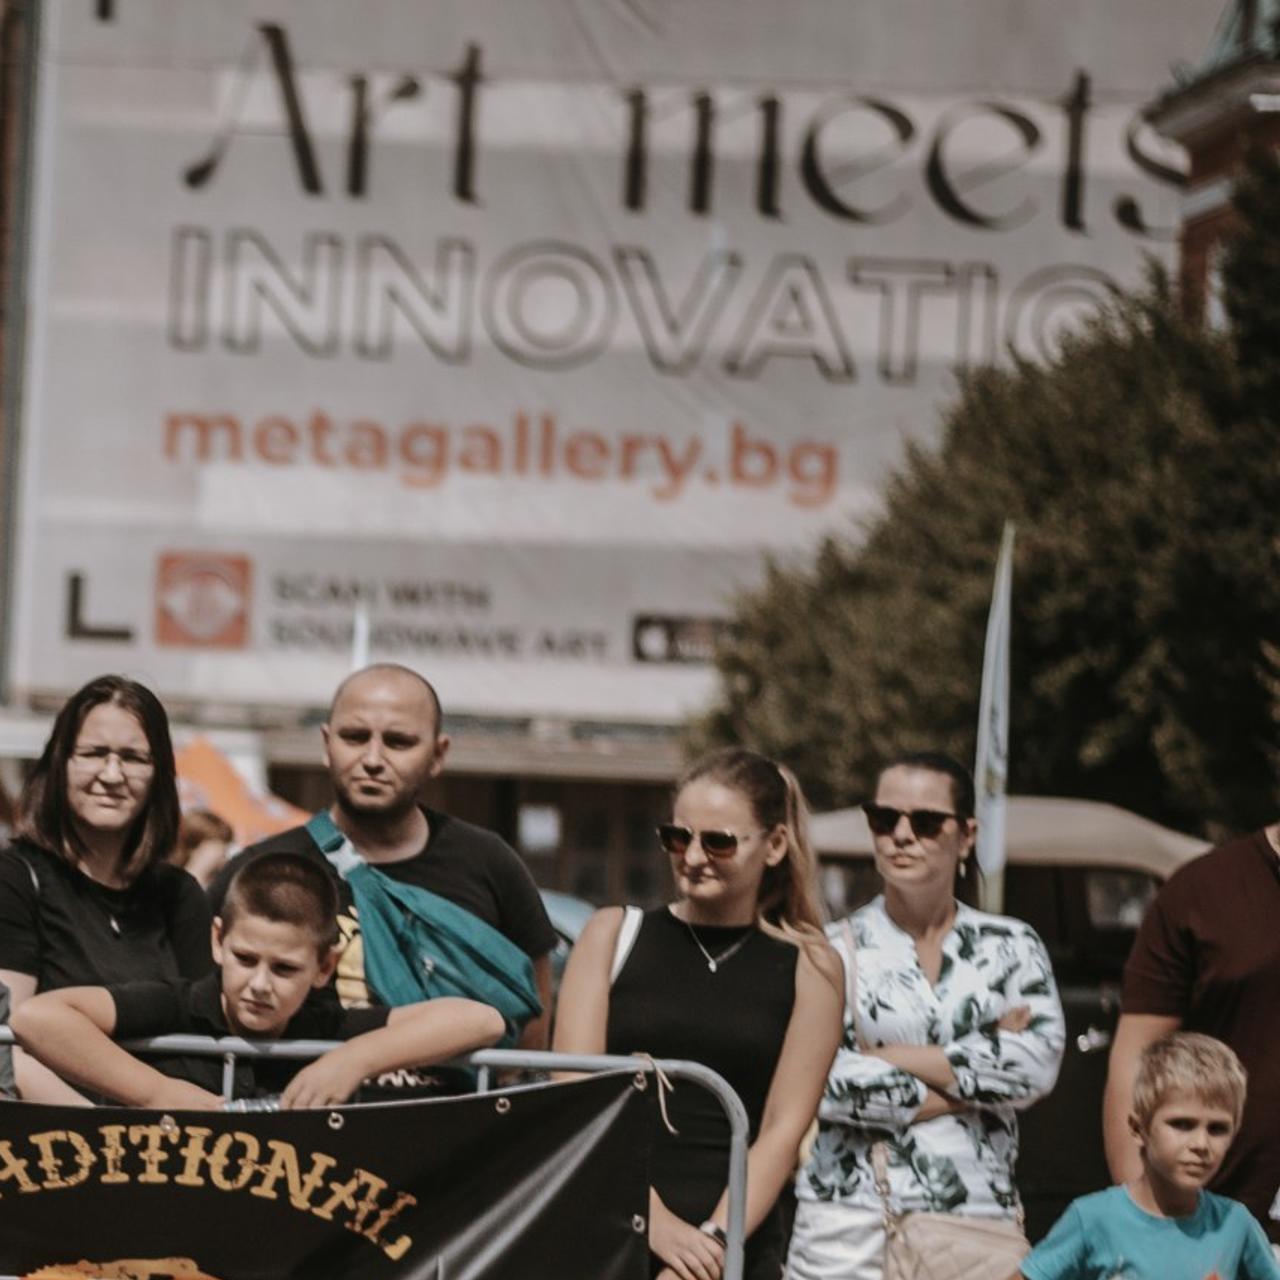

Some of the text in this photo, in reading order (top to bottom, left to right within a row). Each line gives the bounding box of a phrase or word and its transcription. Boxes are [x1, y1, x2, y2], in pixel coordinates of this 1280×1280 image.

[182, 22, 1192, 239] Art meets
[161, 406, 838, 508] metagallery.bg
